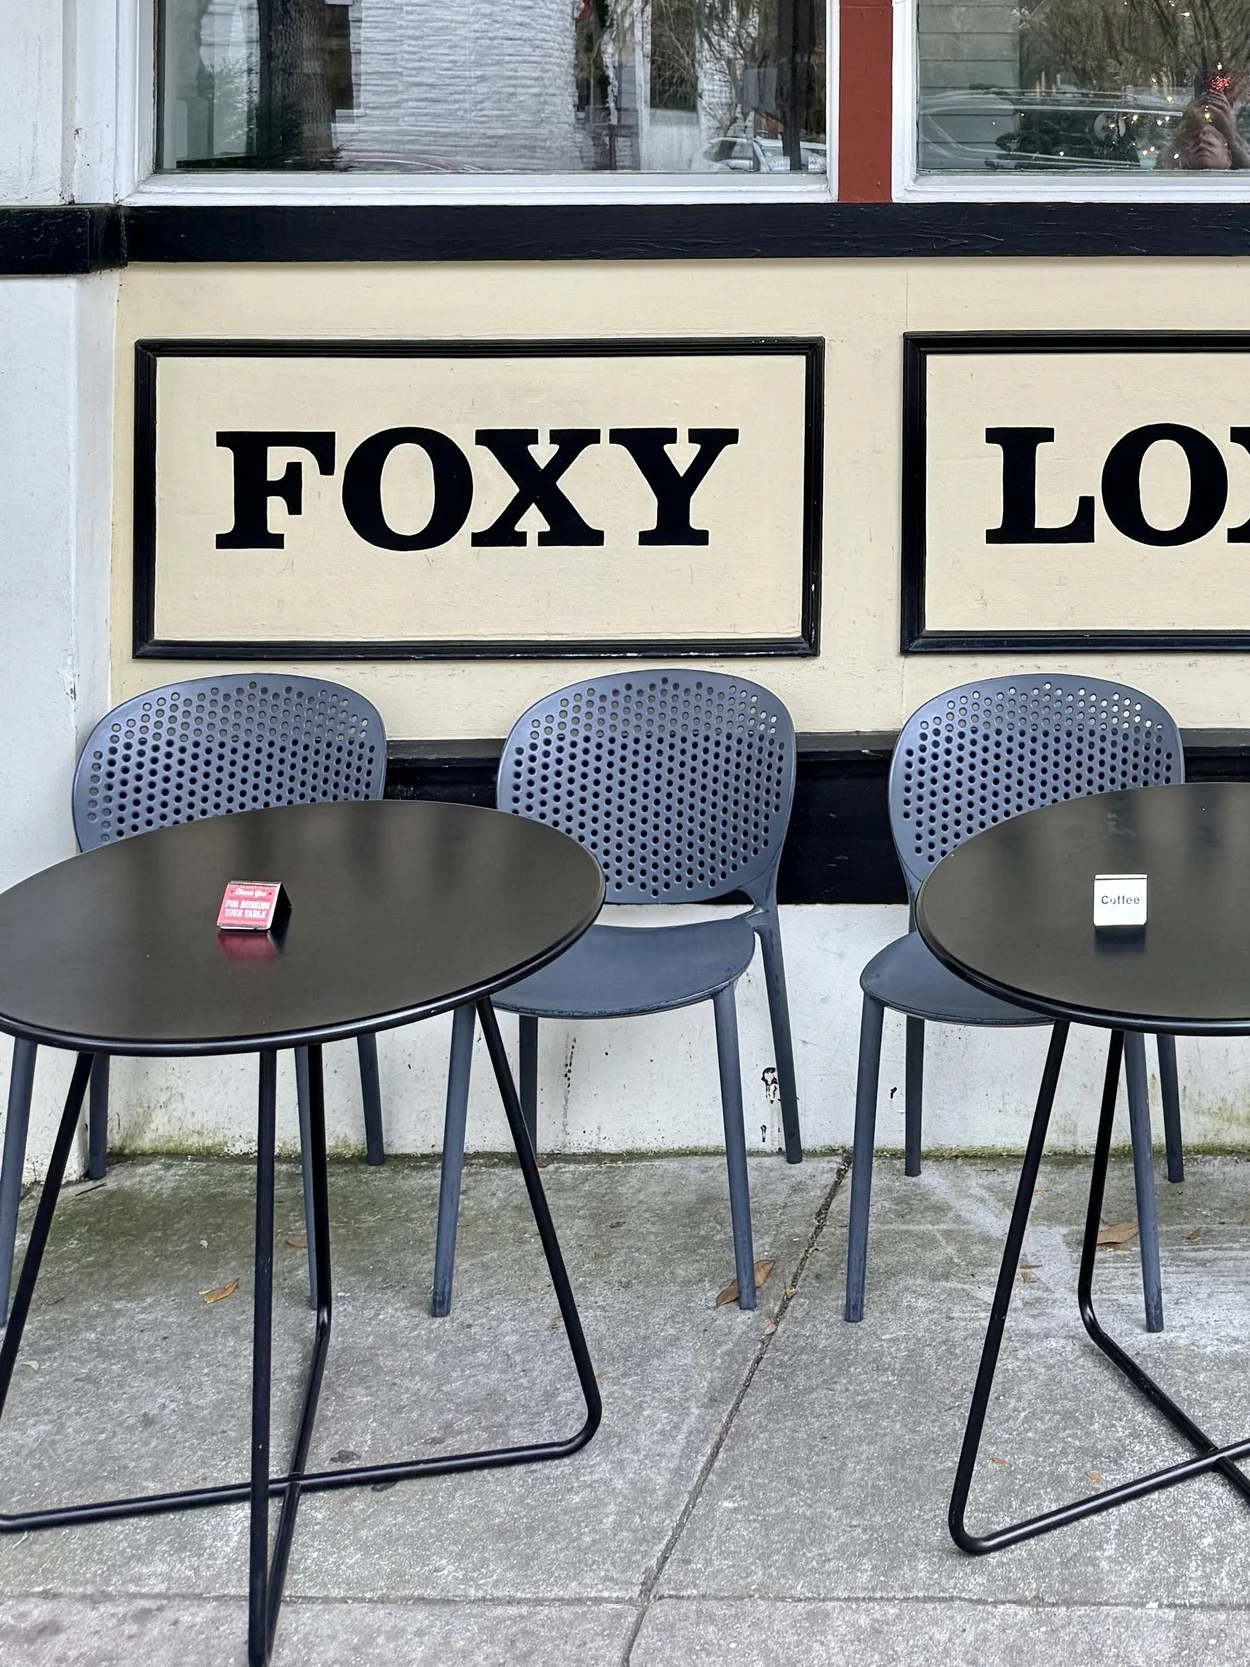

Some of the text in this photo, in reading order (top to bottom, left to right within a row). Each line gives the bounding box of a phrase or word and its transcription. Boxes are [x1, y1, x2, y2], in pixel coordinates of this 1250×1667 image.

[216, 427, 739, 551] FOXY
[226, 899, 239, 908] FOR
[1101, 895, 1140, 904] Coffee
[225, 908, 268, 919] YOUR TABLE
